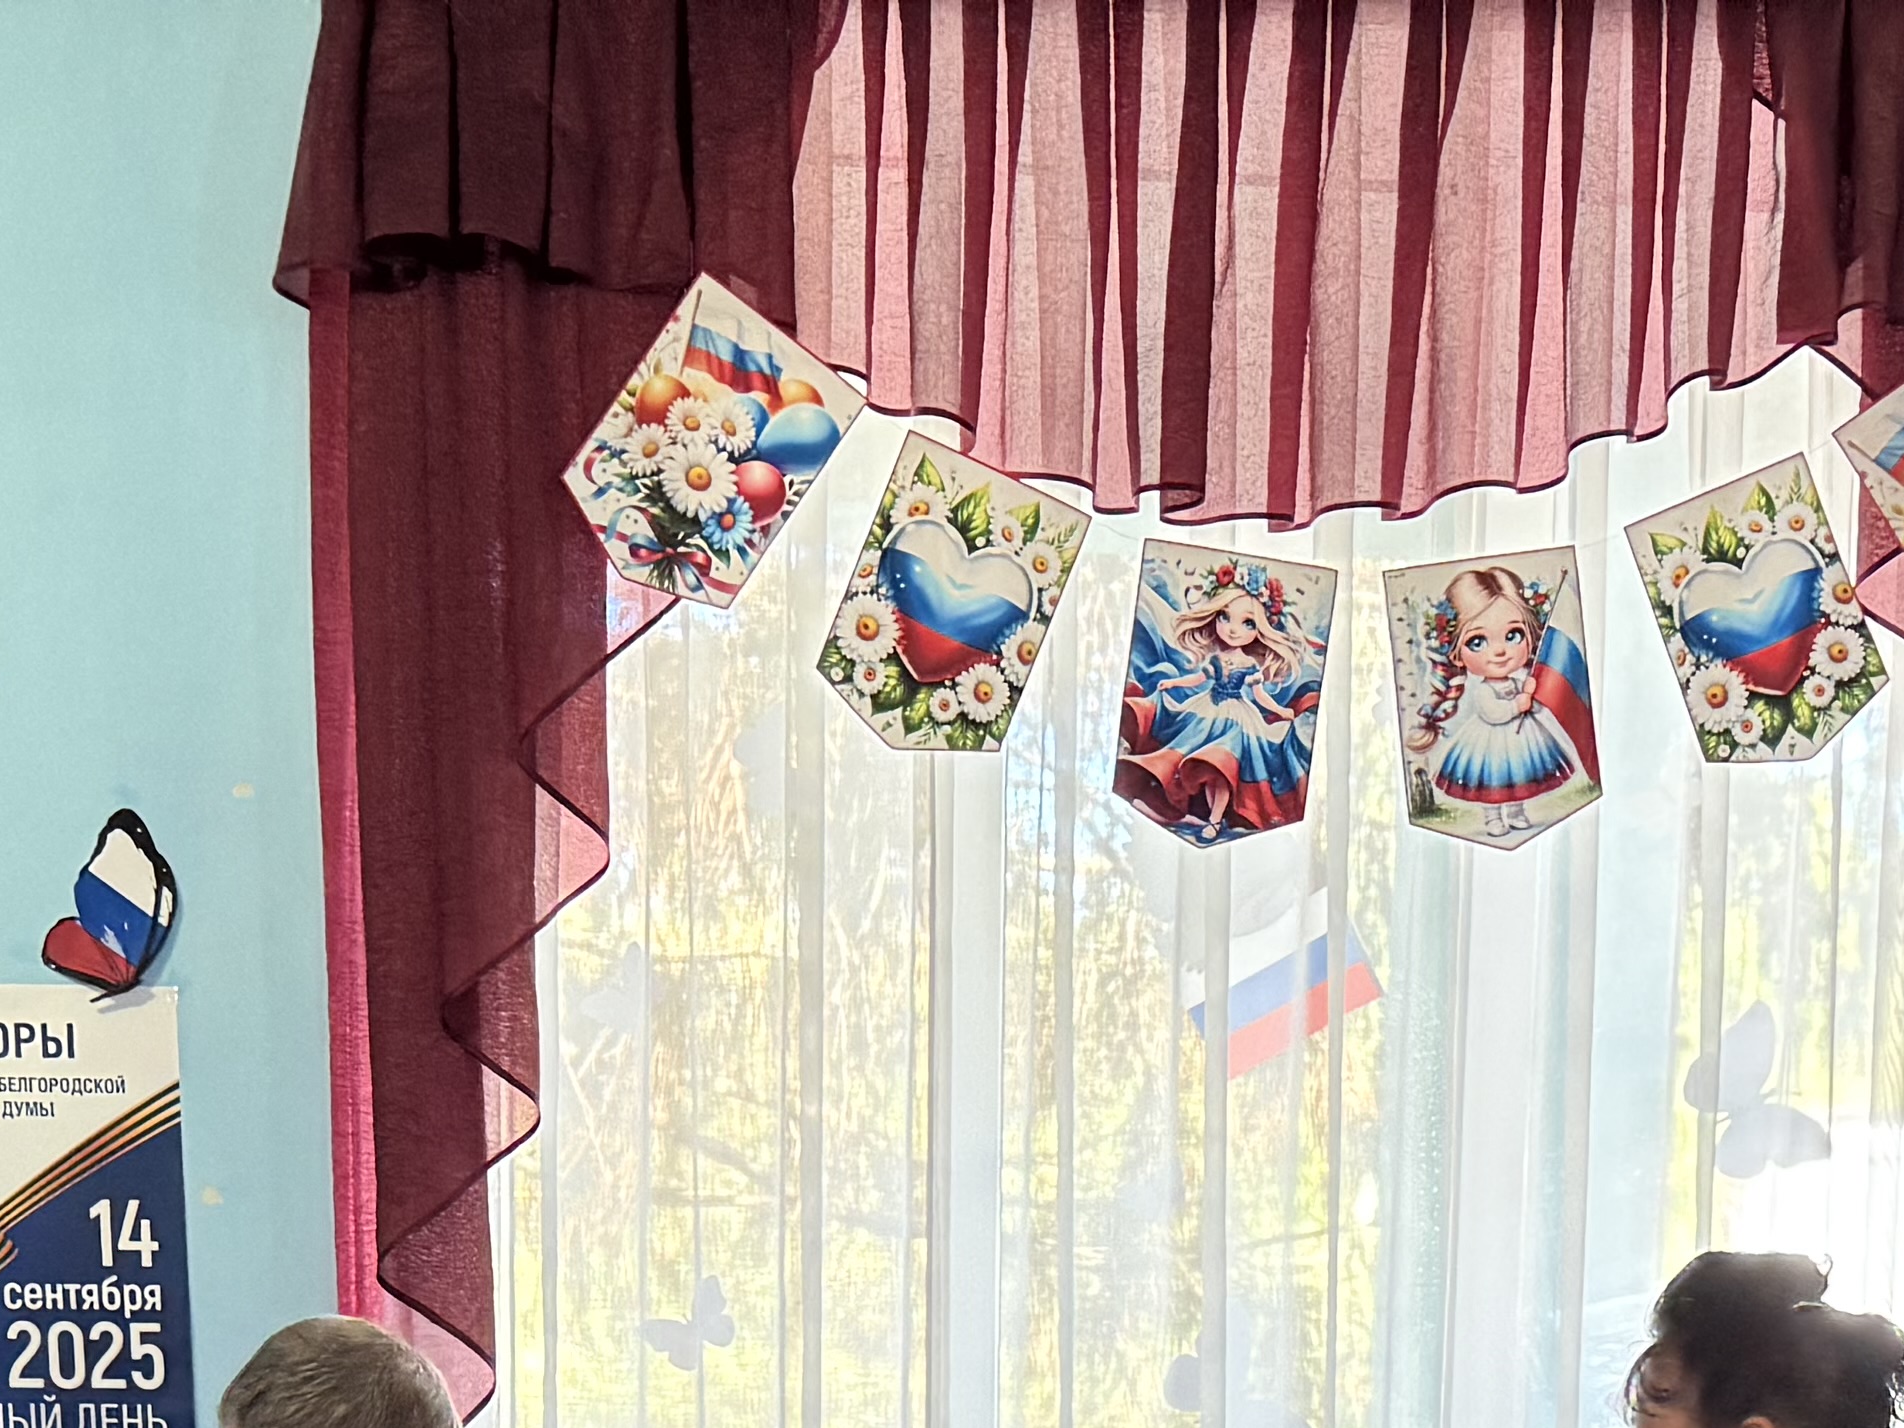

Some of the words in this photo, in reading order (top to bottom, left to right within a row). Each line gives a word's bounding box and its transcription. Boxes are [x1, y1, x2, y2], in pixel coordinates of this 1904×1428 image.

[2, 1100, 55, 1119] ДУМЫ
[89, 1198, 160, 1268] 14
[3, 1275, 162, 1319] сентября
[6, 1320, 166, 1390] 2025
